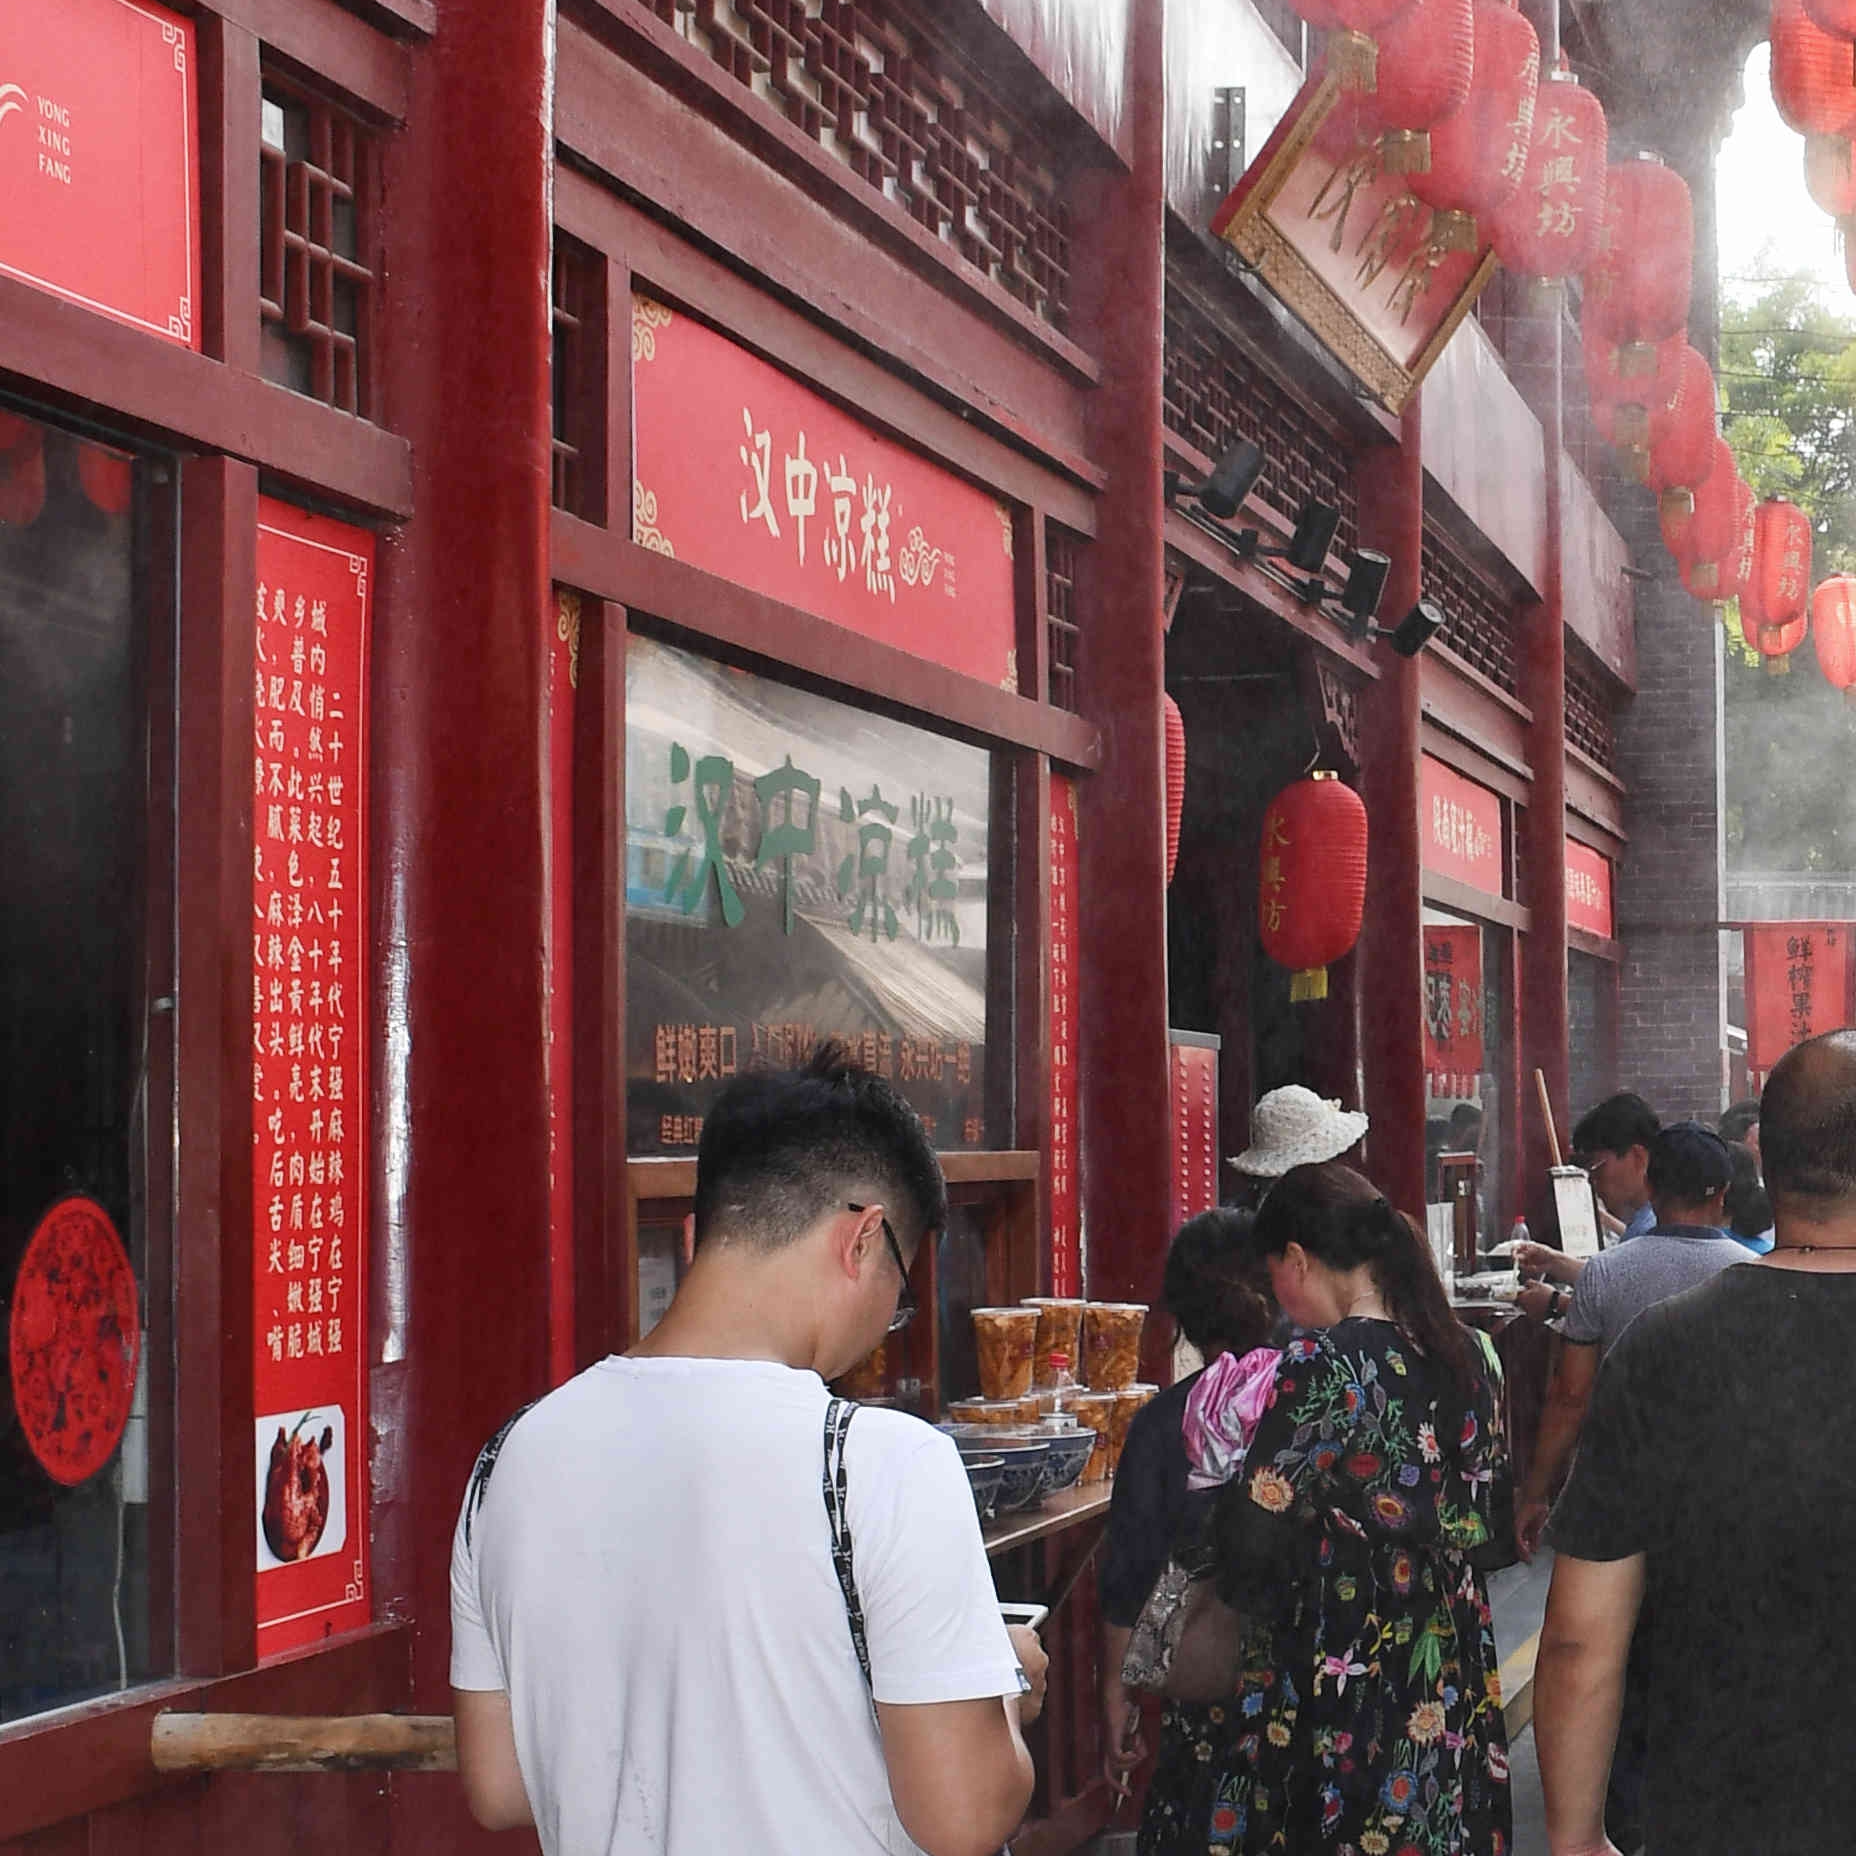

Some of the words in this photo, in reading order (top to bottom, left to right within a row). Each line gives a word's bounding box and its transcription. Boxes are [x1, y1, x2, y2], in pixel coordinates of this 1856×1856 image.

[36, 94, 71, 128] YONG
[37, 124, 71, 157] XING
[38, 152, 72, 185] FANG
[1535, 107, 1584, 238] 永興坊
[739, 405, 896, 605] 汉中凉糕
[655, 1023, 737, 1083] 鲜嫩爽口
